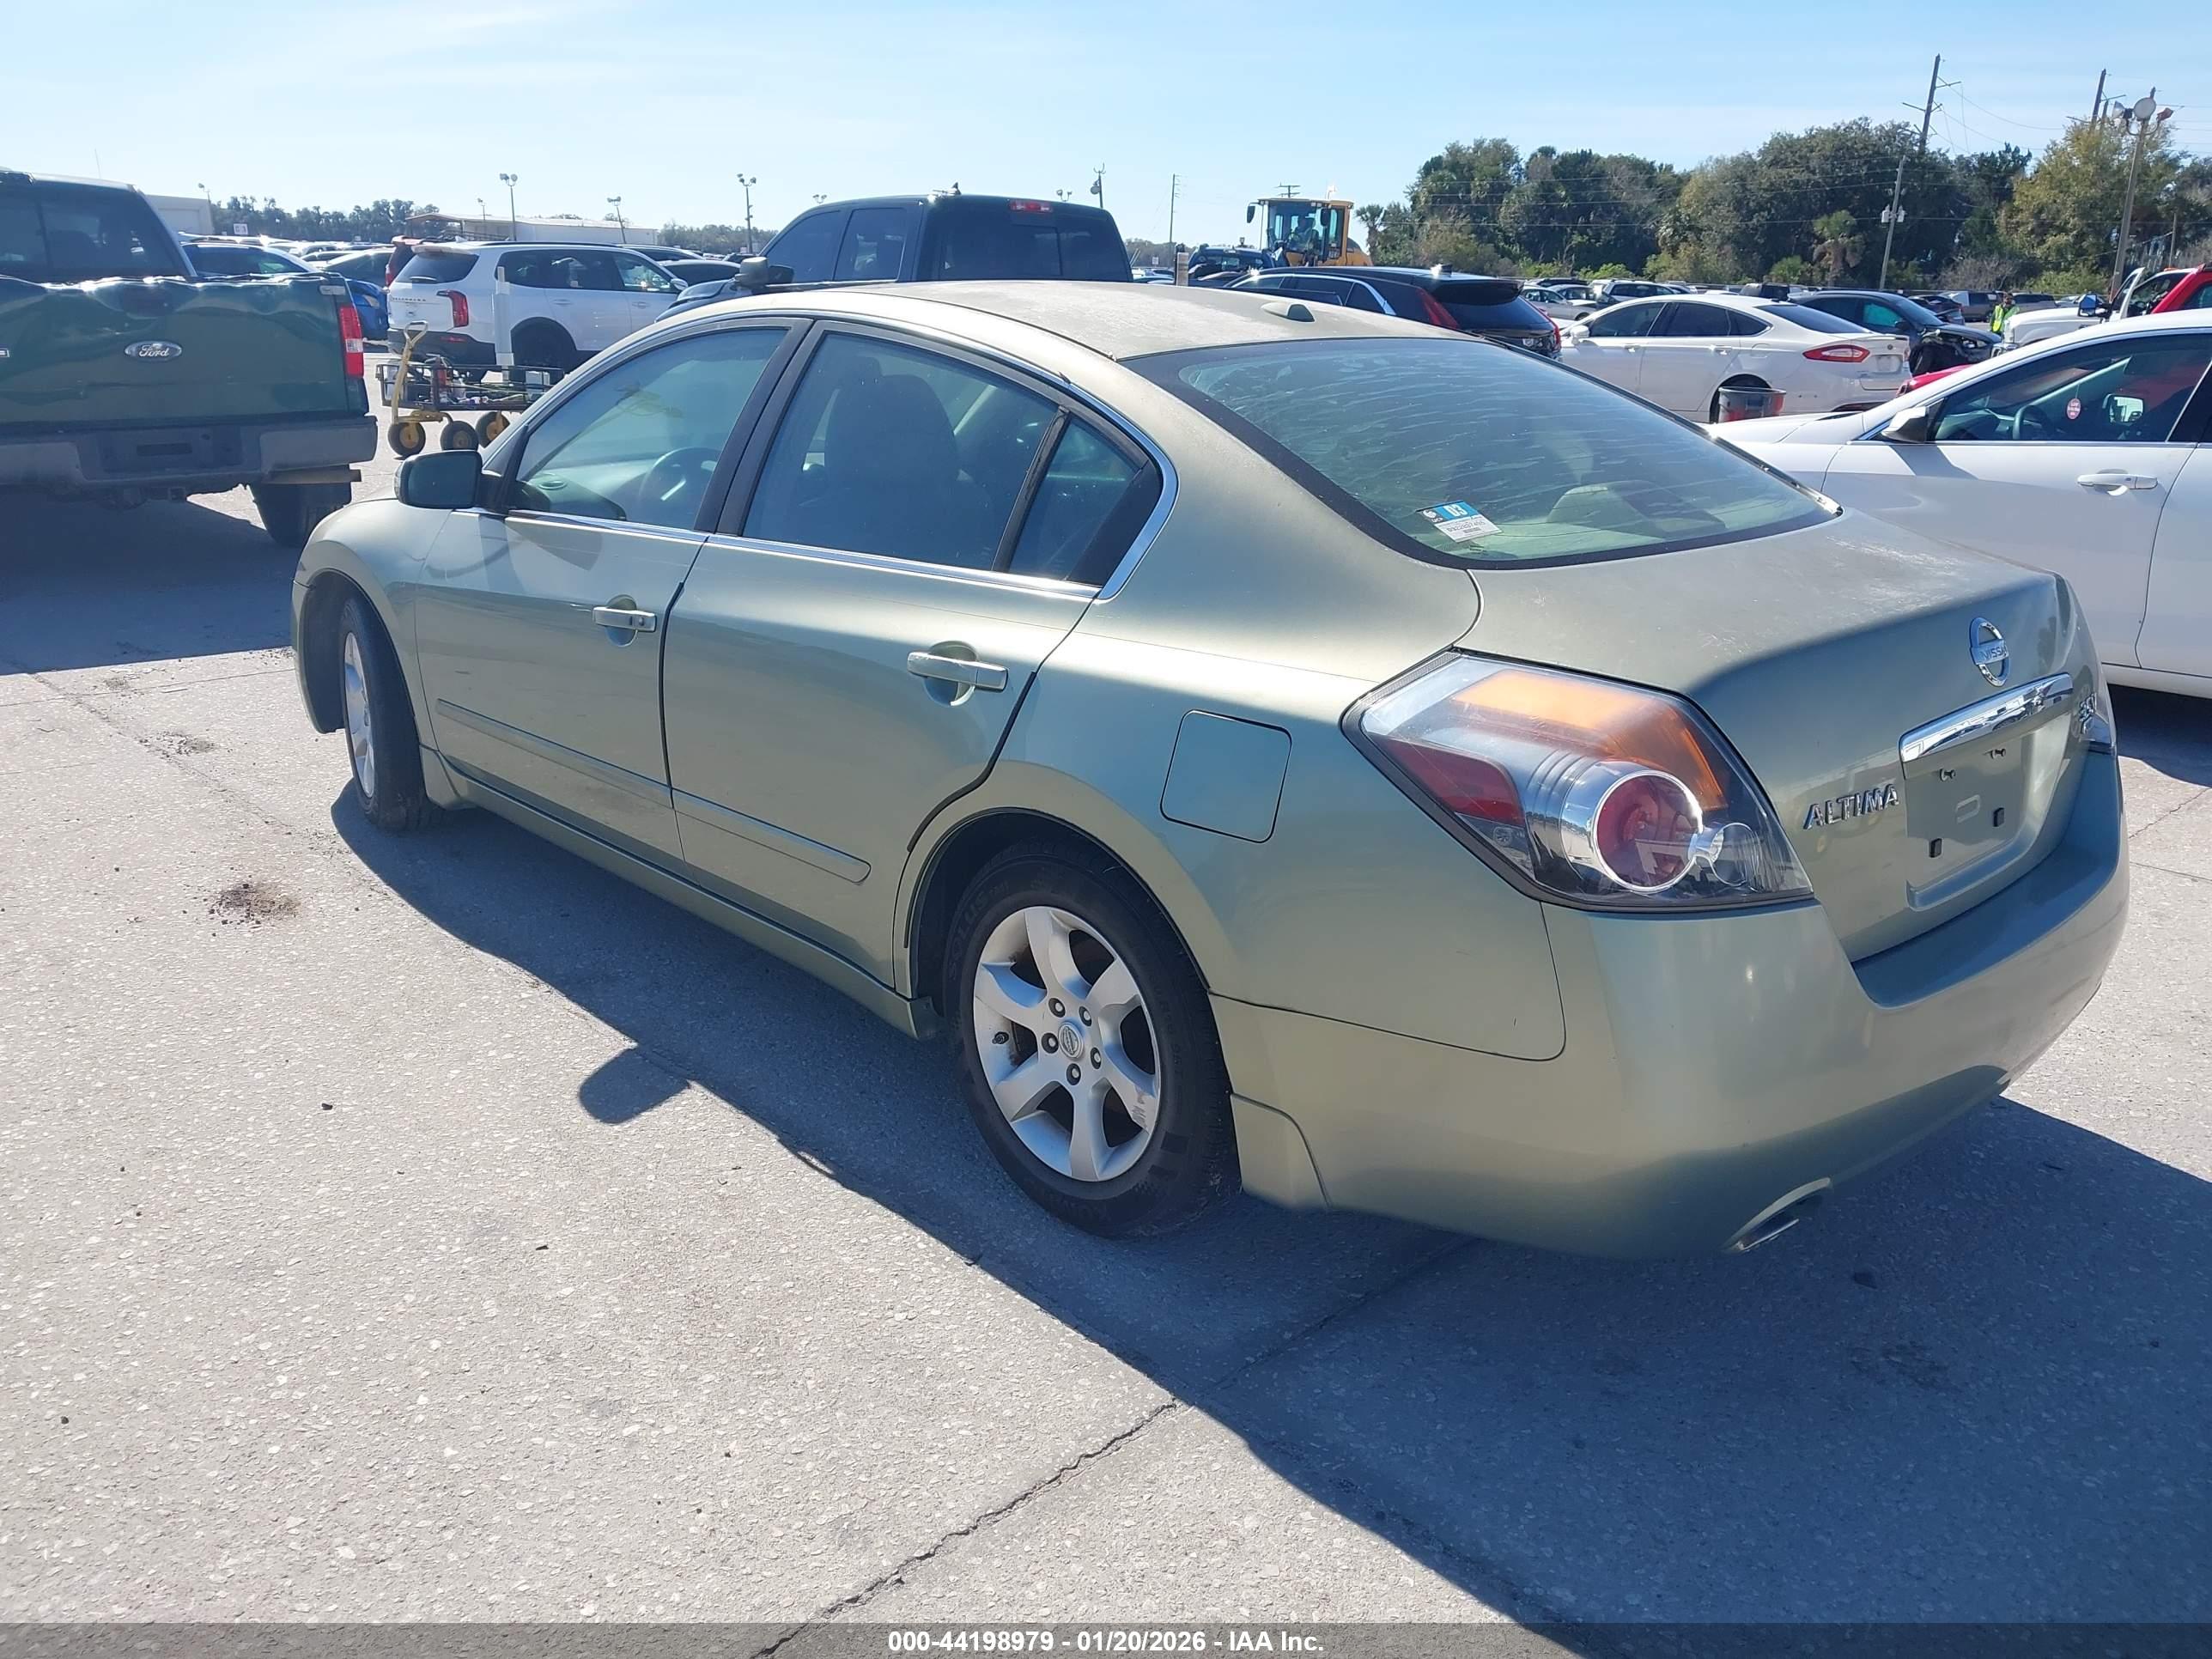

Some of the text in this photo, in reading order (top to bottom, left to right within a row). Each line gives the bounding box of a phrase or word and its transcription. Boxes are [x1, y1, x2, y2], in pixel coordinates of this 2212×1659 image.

[138, 343, 170, 357] Ford
[1442, 504, 1468, 517] 03
[1803, 783, 1899, 830] ALTIMA
